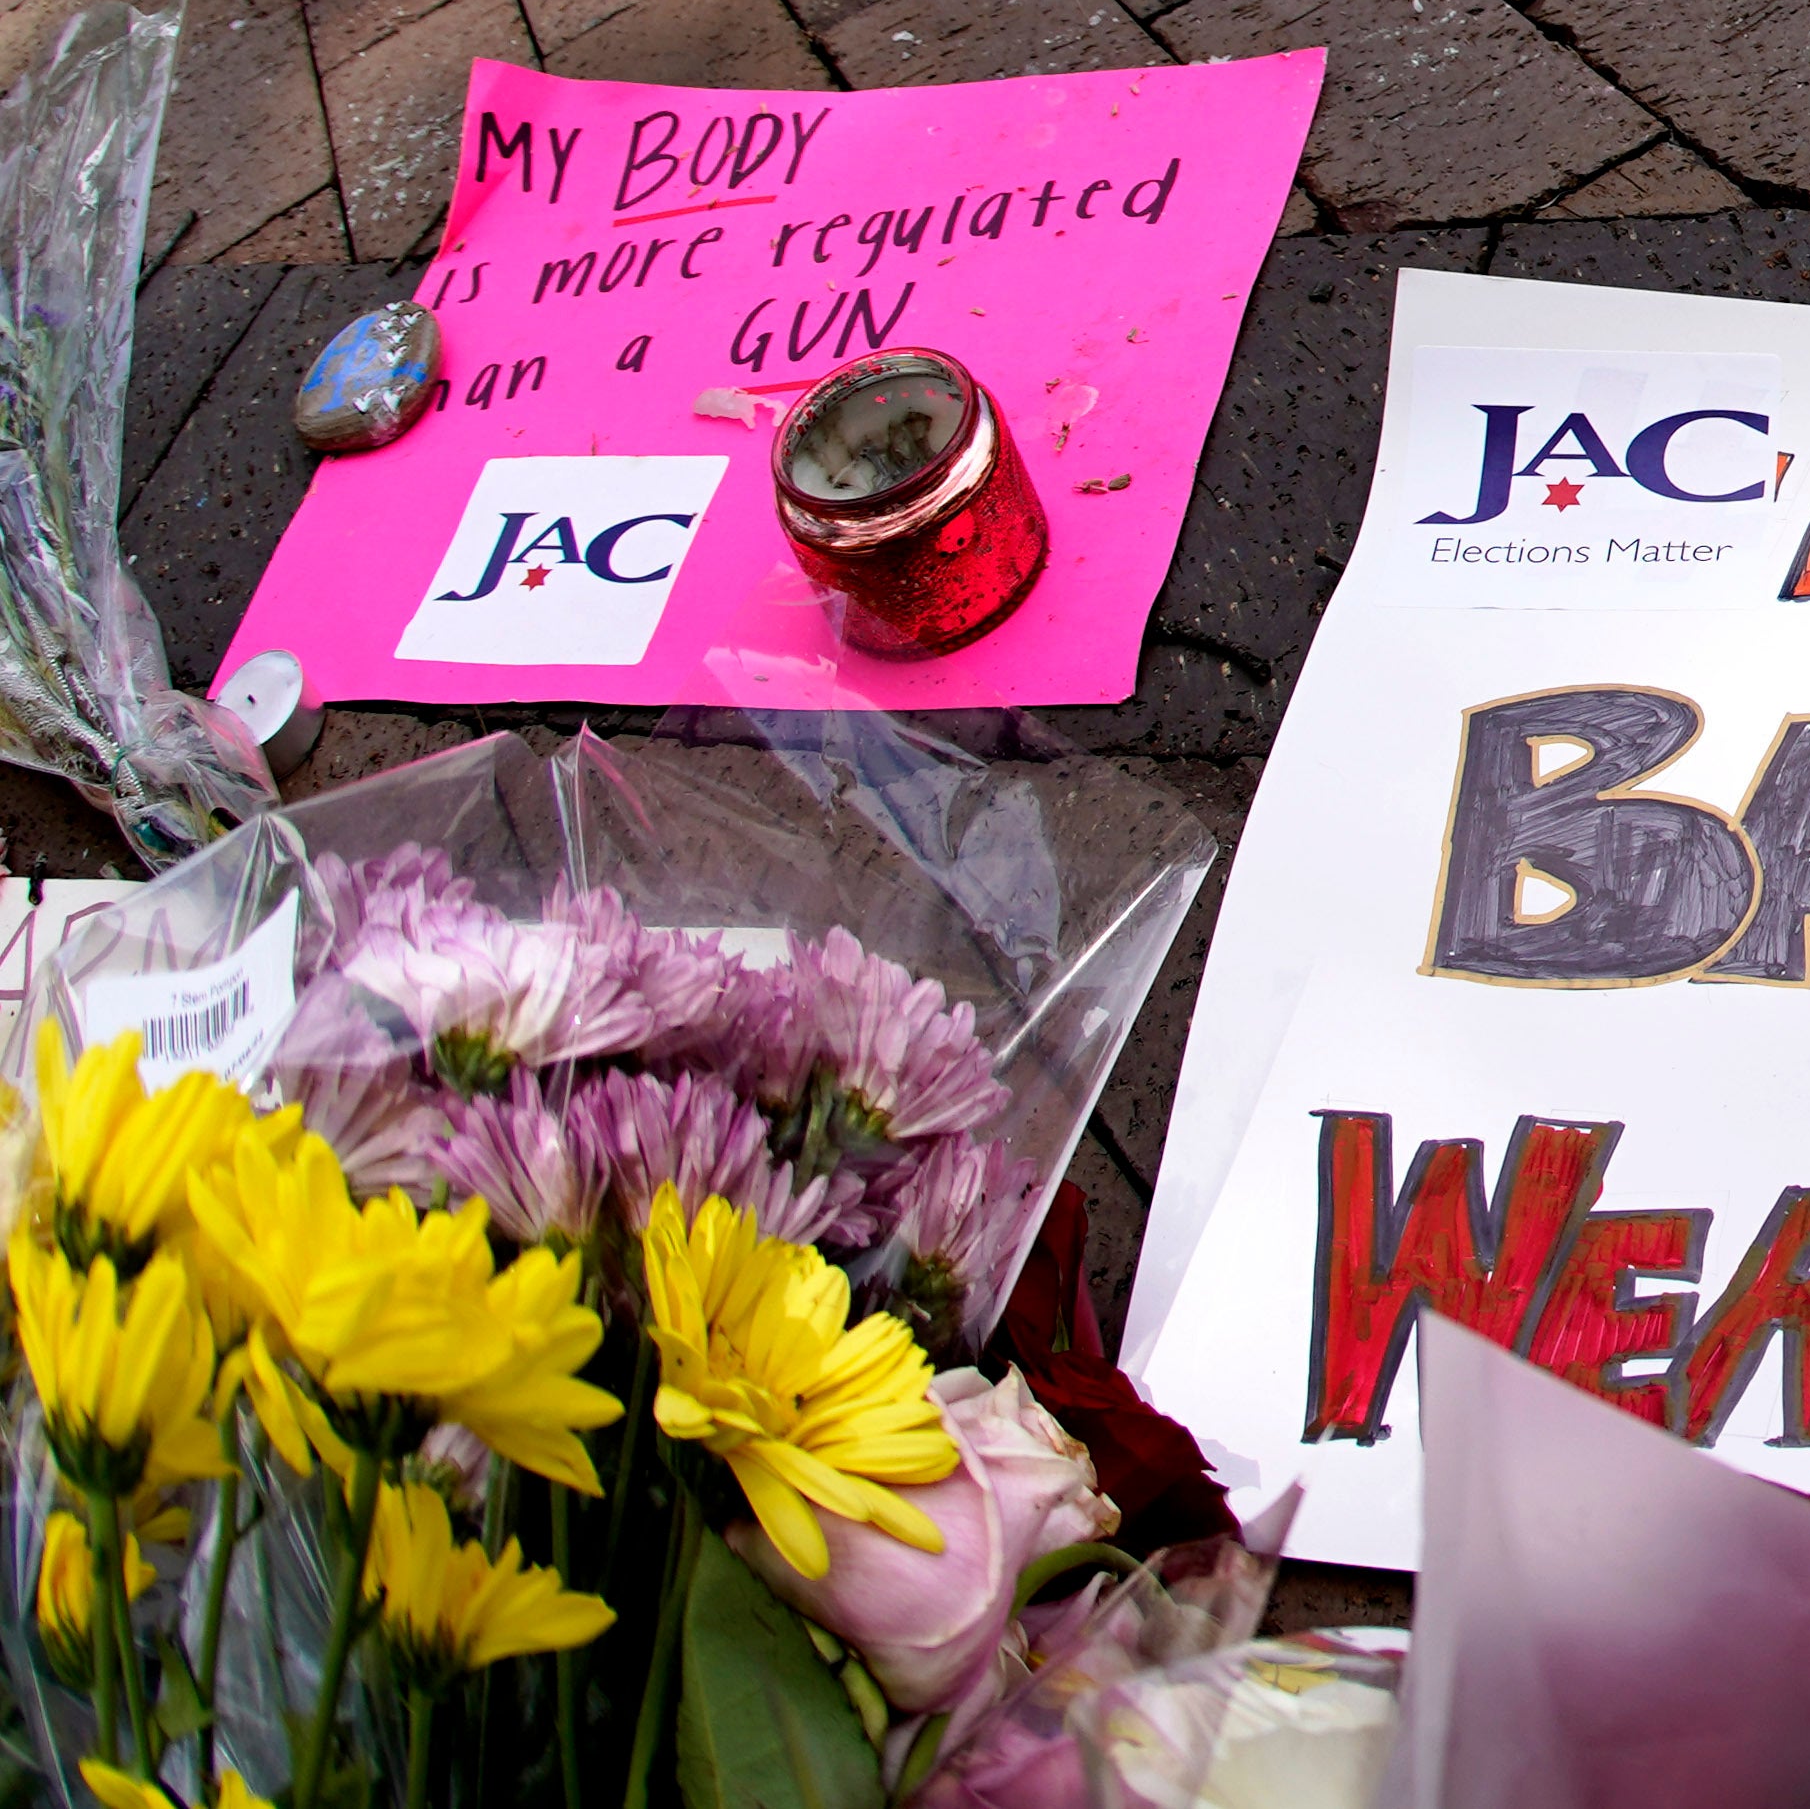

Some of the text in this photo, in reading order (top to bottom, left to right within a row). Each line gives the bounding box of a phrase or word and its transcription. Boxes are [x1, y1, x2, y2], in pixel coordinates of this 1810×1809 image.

[475, 106, 832, 213] MY BODY
[531, 225, 726, 306] more
[771, 156, 1184, 278] regulated
[615, 332, 654, 376] a
[728, 280, 917, 374] GUN
[1415, 401, 1769, 525] JAC
[434, 510, 699, 604] JAC
[1430, 534, 1734, 570] Elections Matter
